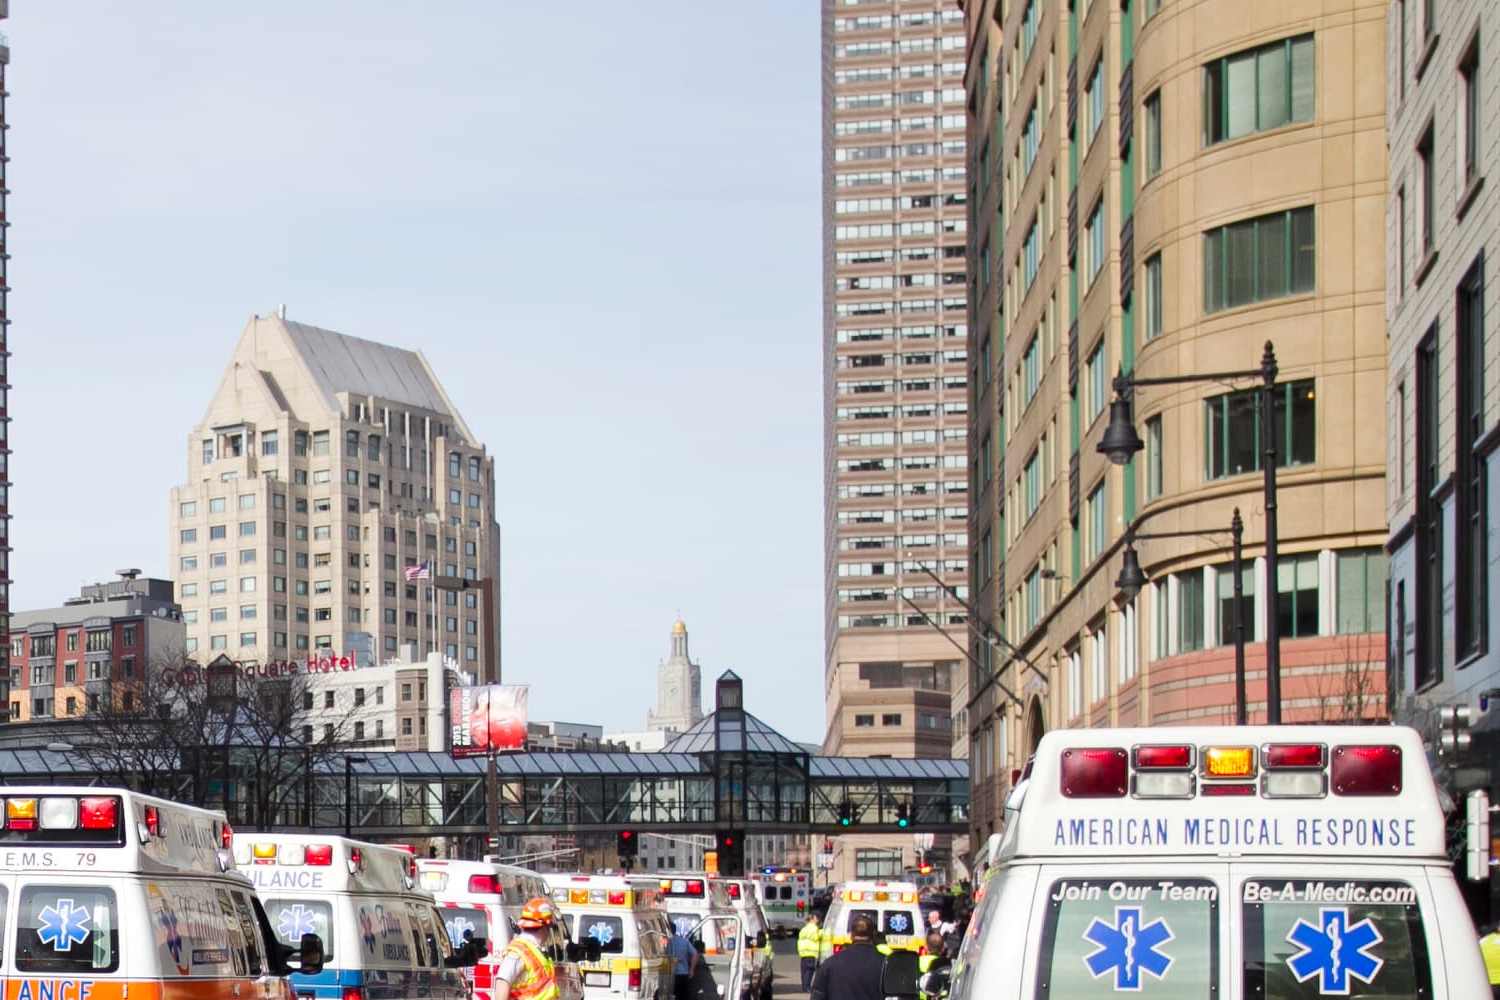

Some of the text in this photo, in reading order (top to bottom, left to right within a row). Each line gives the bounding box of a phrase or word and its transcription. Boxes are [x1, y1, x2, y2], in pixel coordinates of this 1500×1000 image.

[306, 649, 357, 674] Hotel
[462, 688, 471, 746] MARATHON
[452, 725, 462, 746] 2013
[1054, 818, 1416, 847] AMERICAN MEDICAL RESPONSE
[5, 852, 58, 866] E.M.S.
[76, 852, 97, 866] 79
[1051, 881, 1218, 902] Join Our Team
[1243, 881, 1416, 903] Be-A-Medic.com
